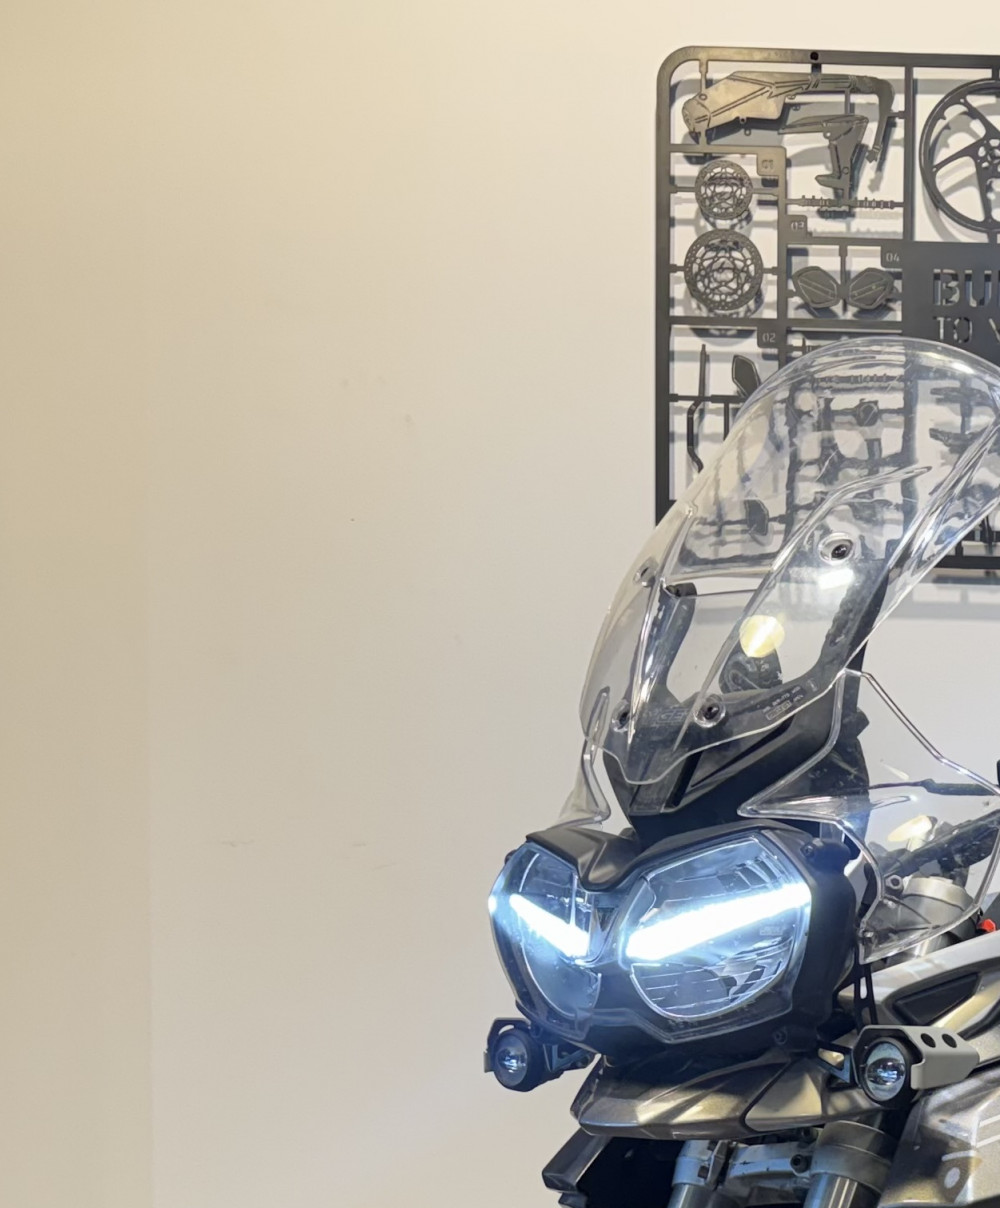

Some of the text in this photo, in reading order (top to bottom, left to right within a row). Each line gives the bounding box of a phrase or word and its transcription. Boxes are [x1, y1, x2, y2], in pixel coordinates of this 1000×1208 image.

[886, 252, 900, 262] 04
[933, 316, 973, 344] TO
[762, 332, 776, 342] 02
